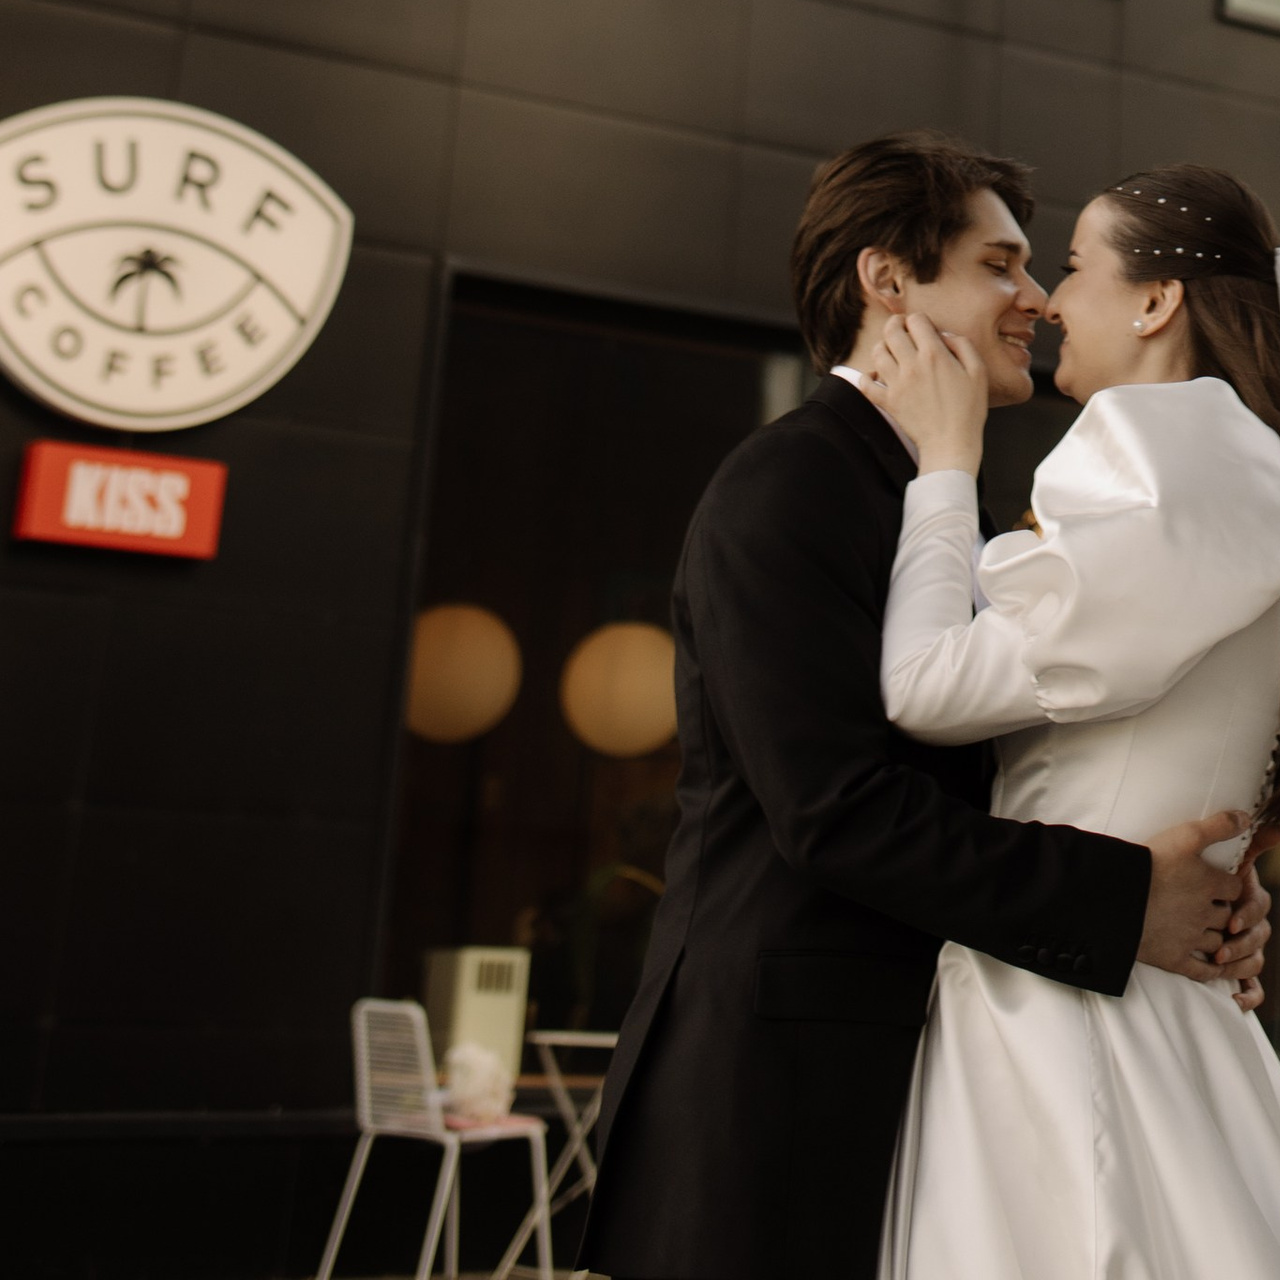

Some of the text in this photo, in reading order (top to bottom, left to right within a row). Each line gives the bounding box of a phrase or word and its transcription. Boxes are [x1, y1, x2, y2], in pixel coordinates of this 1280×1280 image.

[16, 139, 294, 235] SURF
[14, 284, 264, 389] COFFEE
[63, 460, 189, 539] KISS
